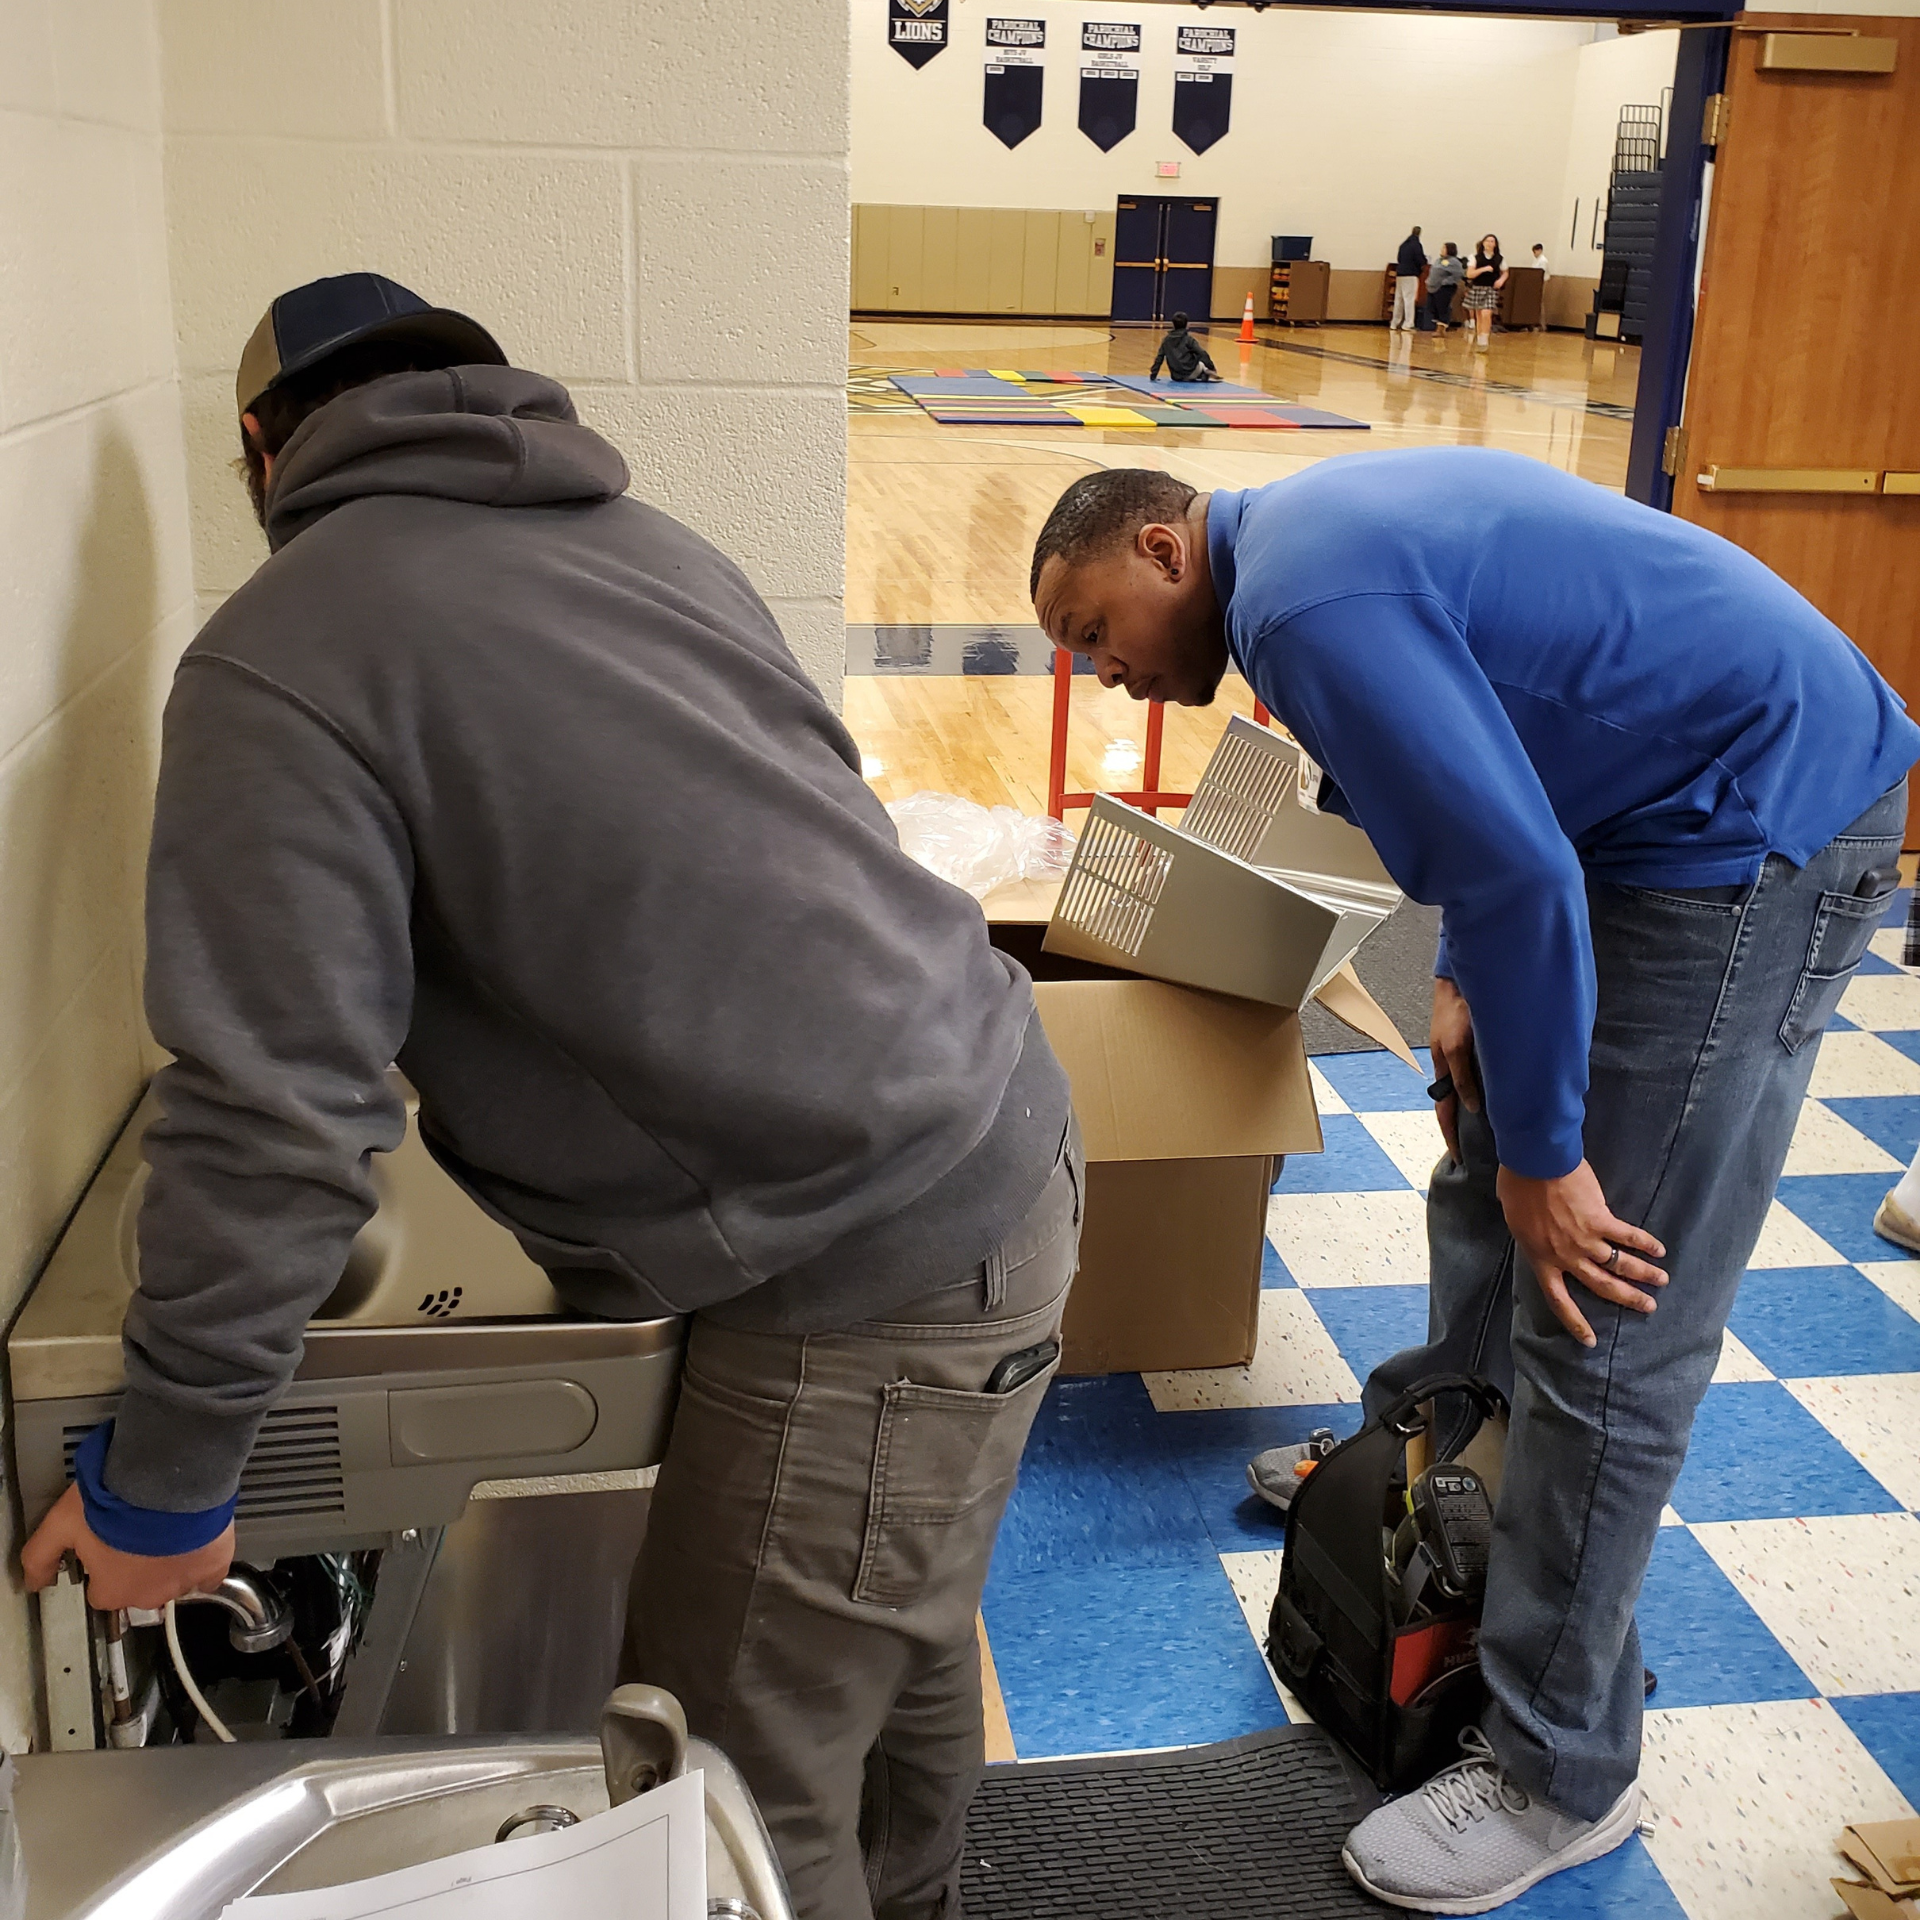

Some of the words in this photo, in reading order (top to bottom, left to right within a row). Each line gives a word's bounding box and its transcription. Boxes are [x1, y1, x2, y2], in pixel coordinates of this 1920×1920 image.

[894, 21, 943, 41] LIONS
[987, 29, 1044, 45] CHAMPIONS
[1083, 33, 1139, 49] CHAMPIONS
[1178, 37, 1234, 53] CHAMPIONS
